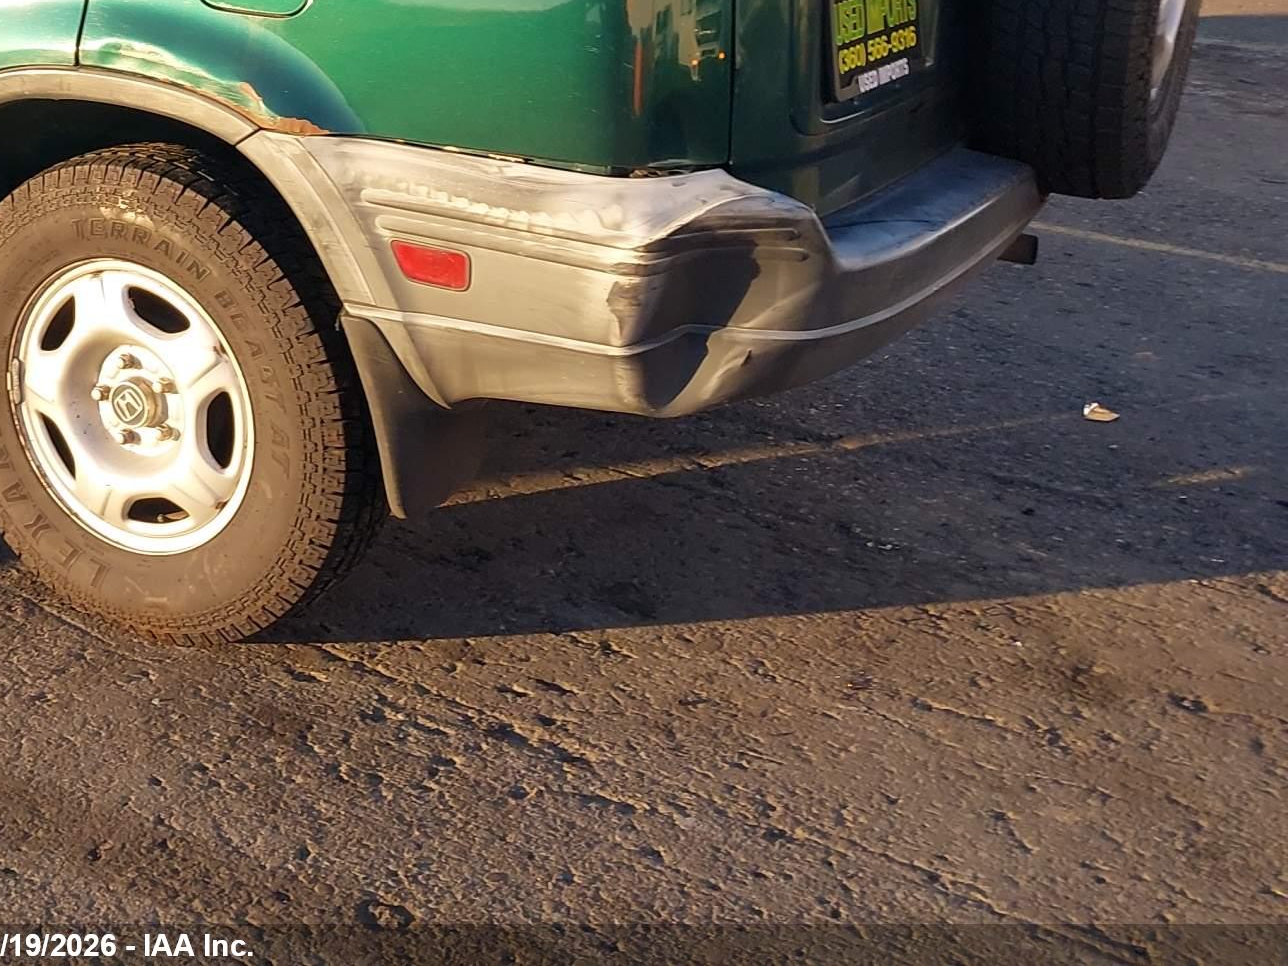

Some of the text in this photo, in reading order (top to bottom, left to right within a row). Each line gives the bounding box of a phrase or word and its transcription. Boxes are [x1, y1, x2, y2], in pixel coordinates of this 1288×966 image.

[838, 26, 917, 74] (360) 566-9316
[857, 57, 910, 93] USED IMPORTS
[71, 217, 212, 282] TERRAIN
